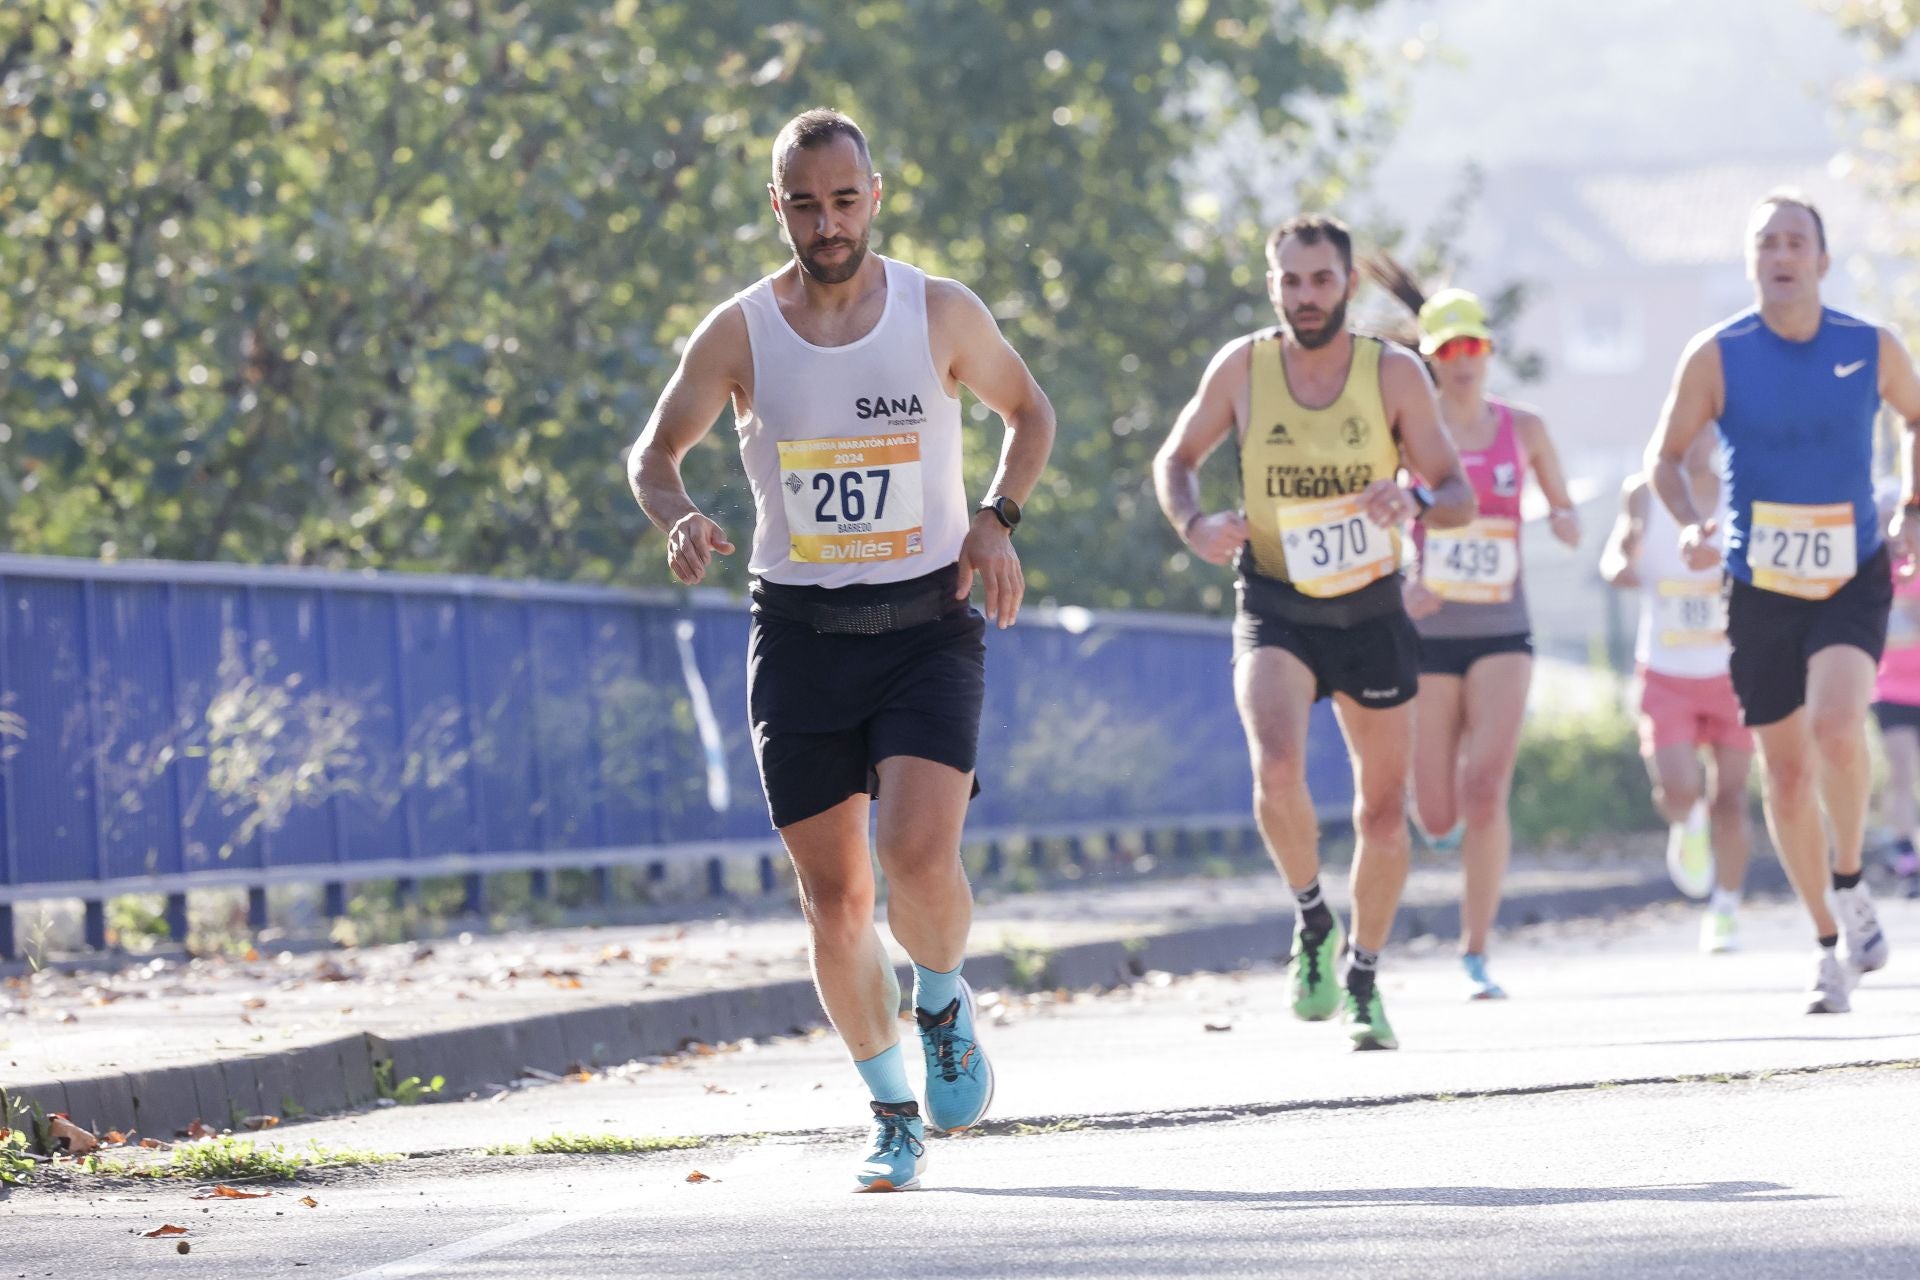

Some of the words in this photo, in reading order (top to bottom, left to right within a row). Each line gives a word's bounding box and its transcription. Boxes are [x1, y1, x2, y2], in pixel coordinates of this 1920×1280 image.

[855, 394, 923, 419] SANA
[838, 437, 886, 449] MARATÓN
[886, 434, 917, 446] AVILÉS
[834, 453, 865, 465] 2024
[812, 469, 890, 522] 267
[822, 540, 893, 559] avilés
[1308, 518, 1367, 567] 370
[1772, 532, 1830, 569] 276
[1447, 541, 1500, 577] 439
